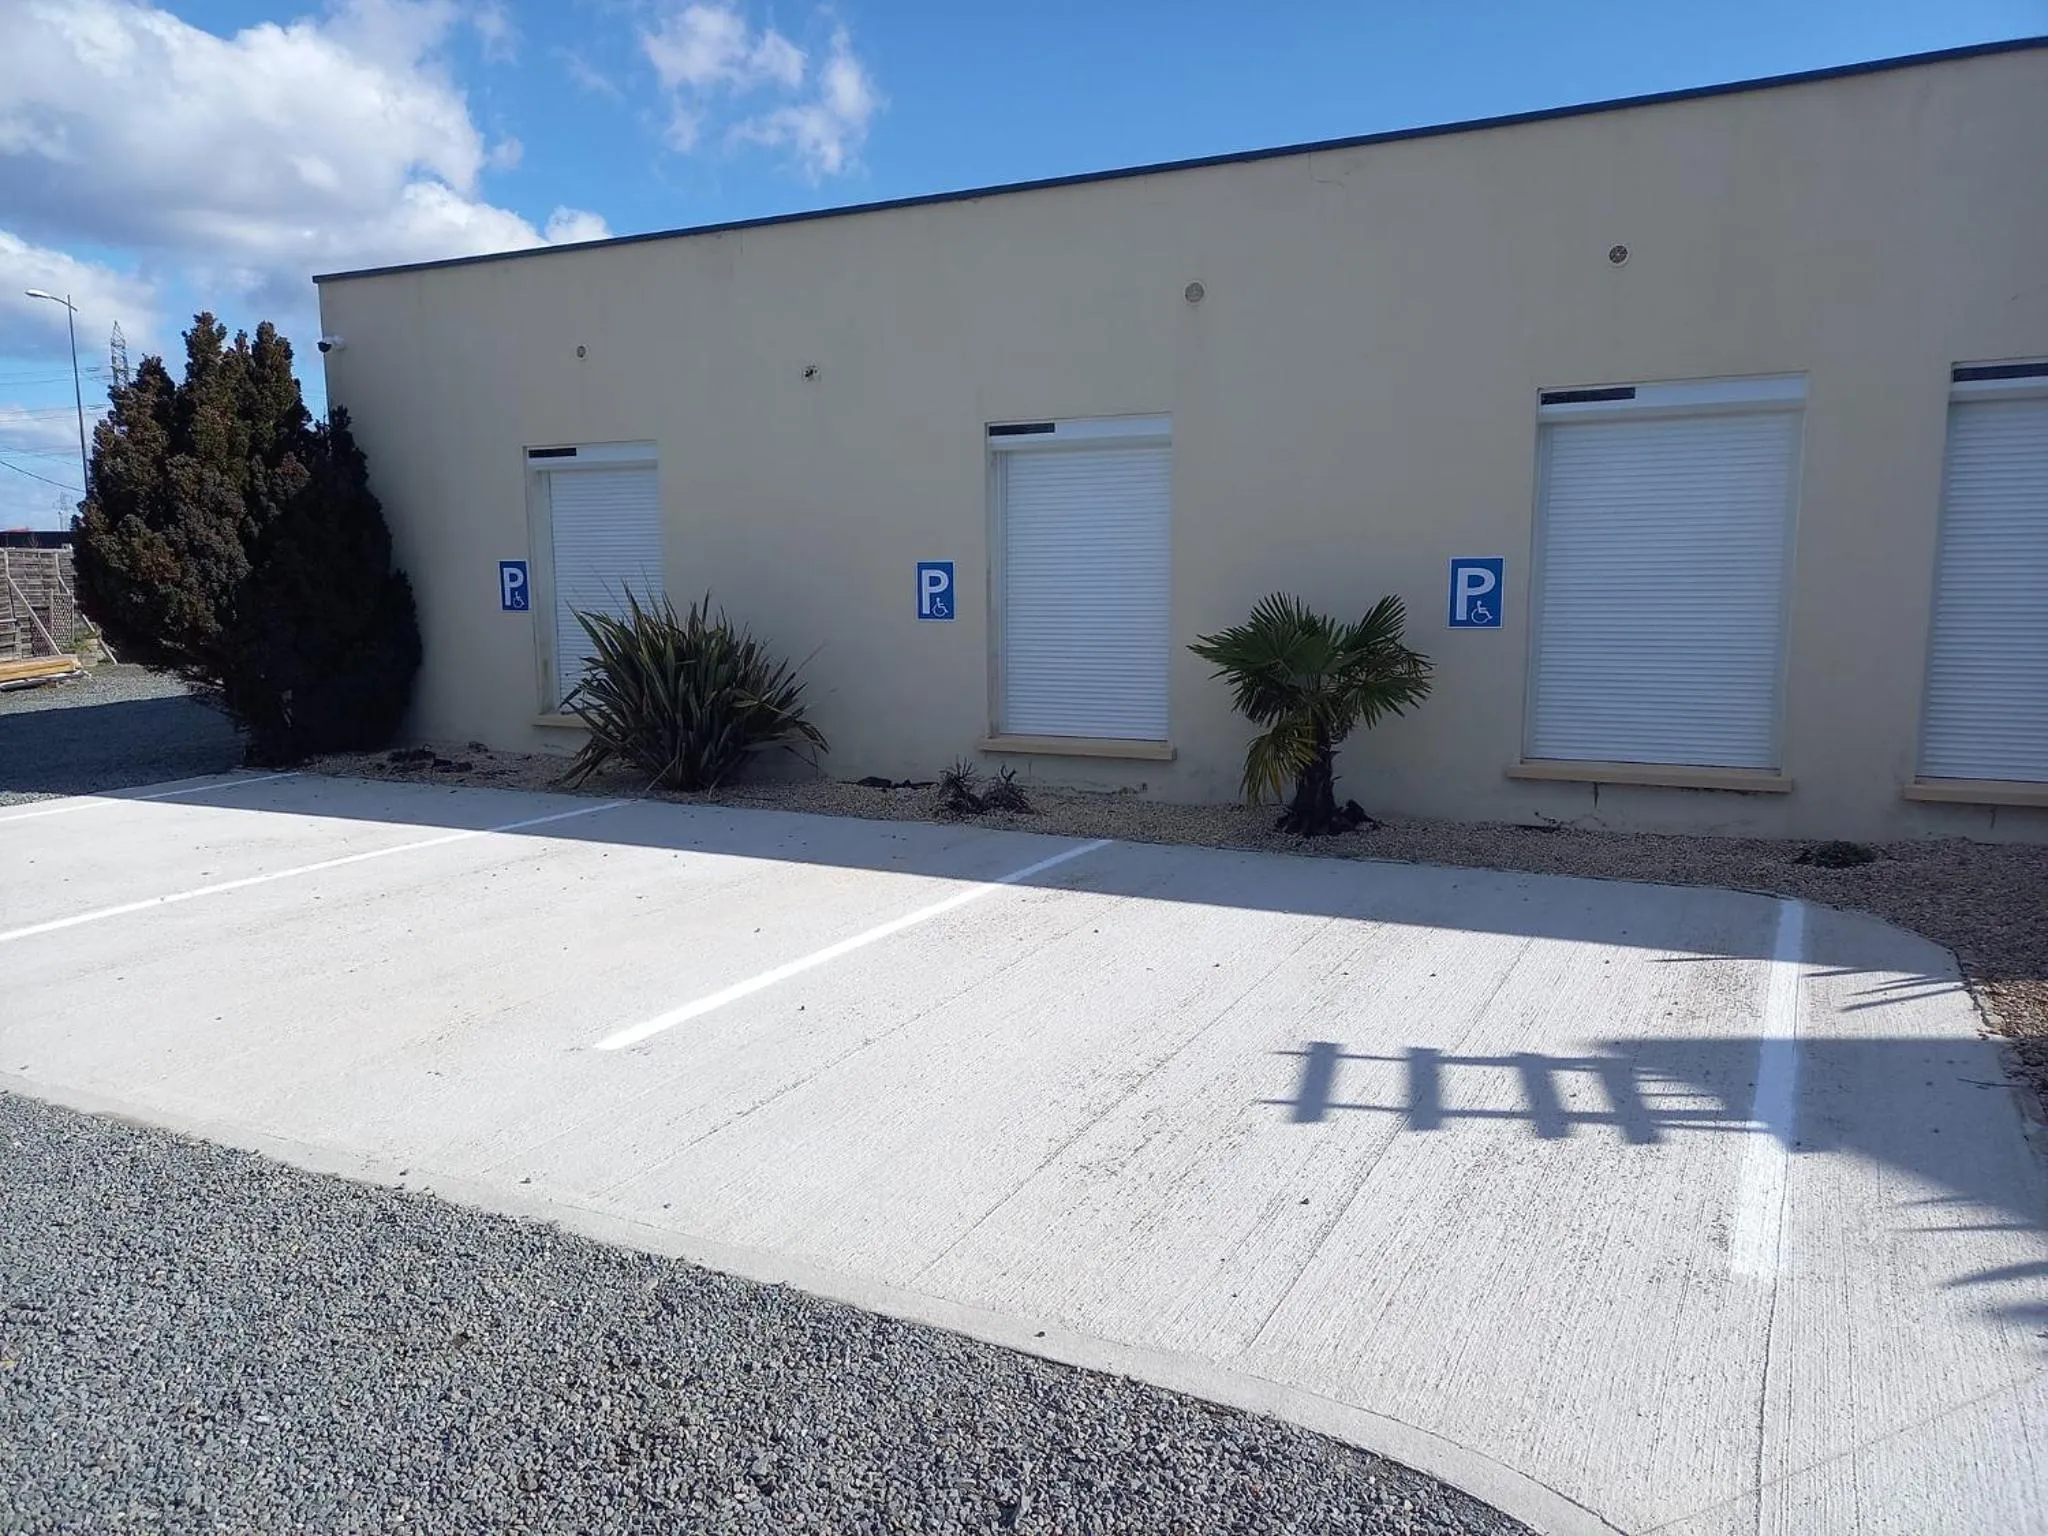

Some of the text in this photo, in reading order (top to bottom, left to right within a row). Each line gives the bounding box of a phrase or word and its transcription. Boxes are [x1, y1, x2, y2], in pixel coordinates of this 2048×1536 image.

[503, 567, 524, 606] P
[921, 569, 949, 614] P
[1456, 567, 1495, 620] P
